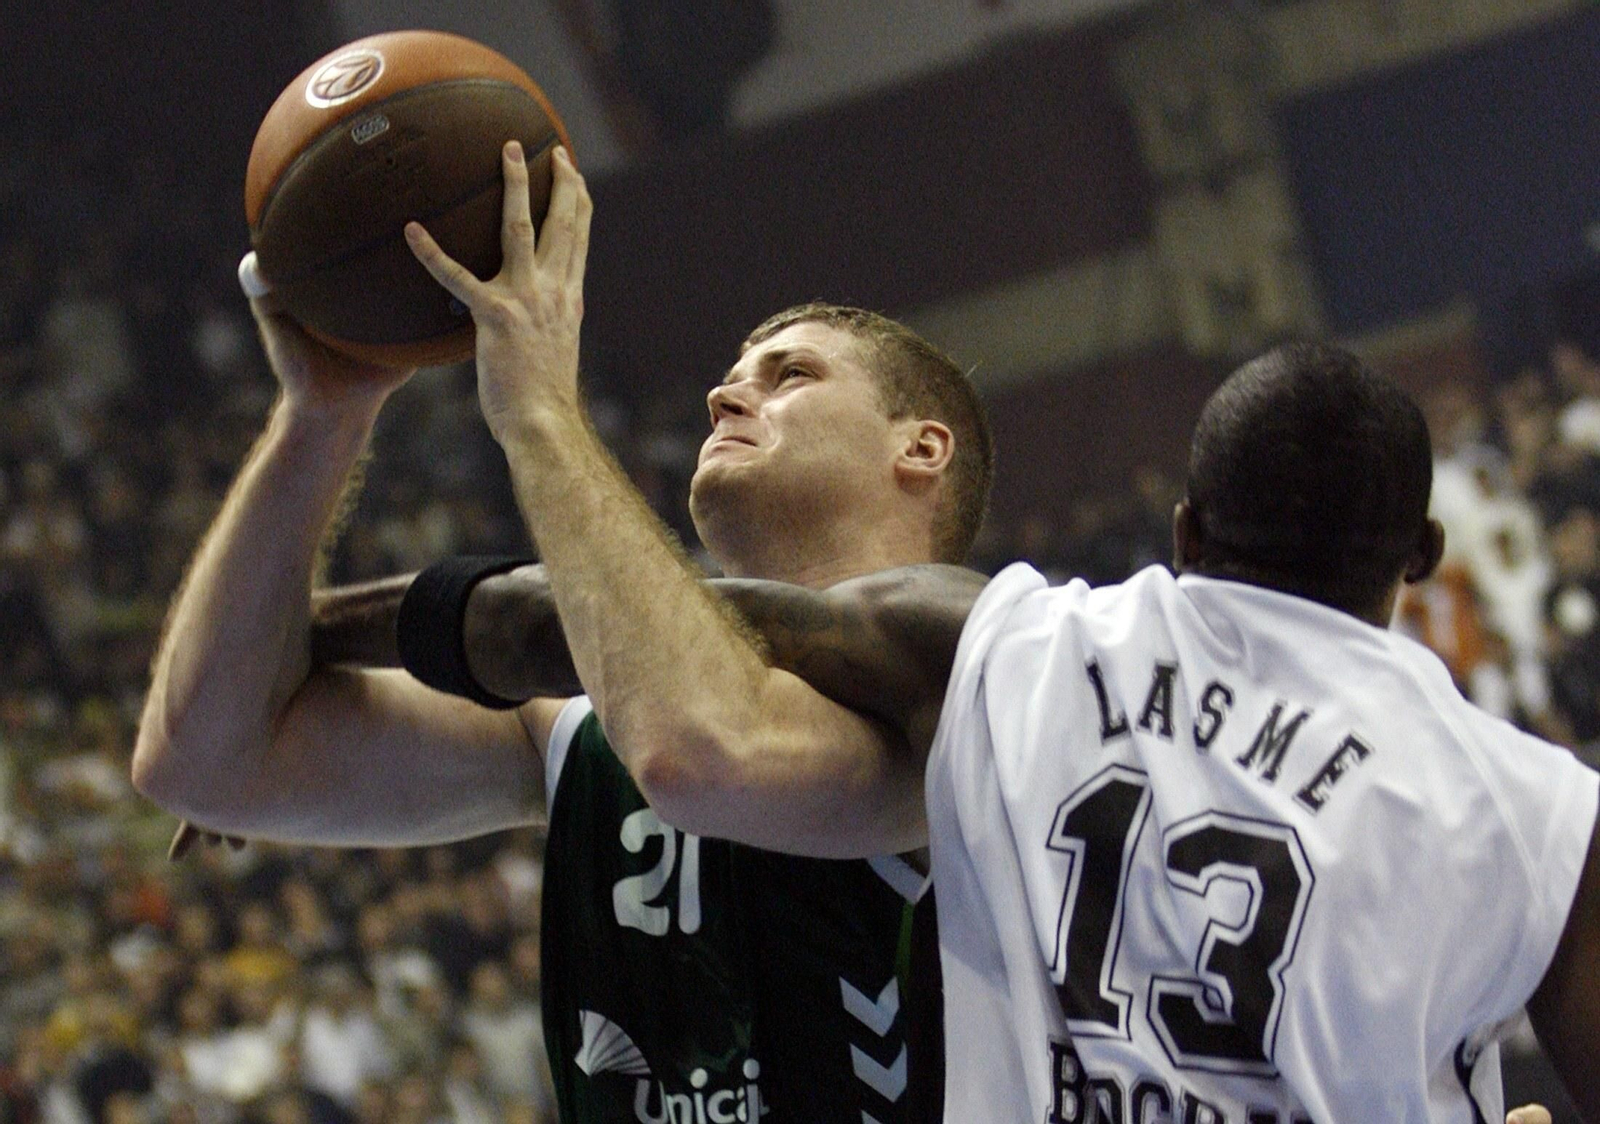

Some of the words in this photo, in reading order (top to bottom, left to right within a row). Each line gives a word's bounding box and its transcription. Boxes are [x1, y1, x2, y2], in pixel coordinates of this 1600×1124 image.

[1085, 656, 1374, 813] LASME
[612, 807, 701, 937] 21
[1046, 763, 1316, 1079] 13
